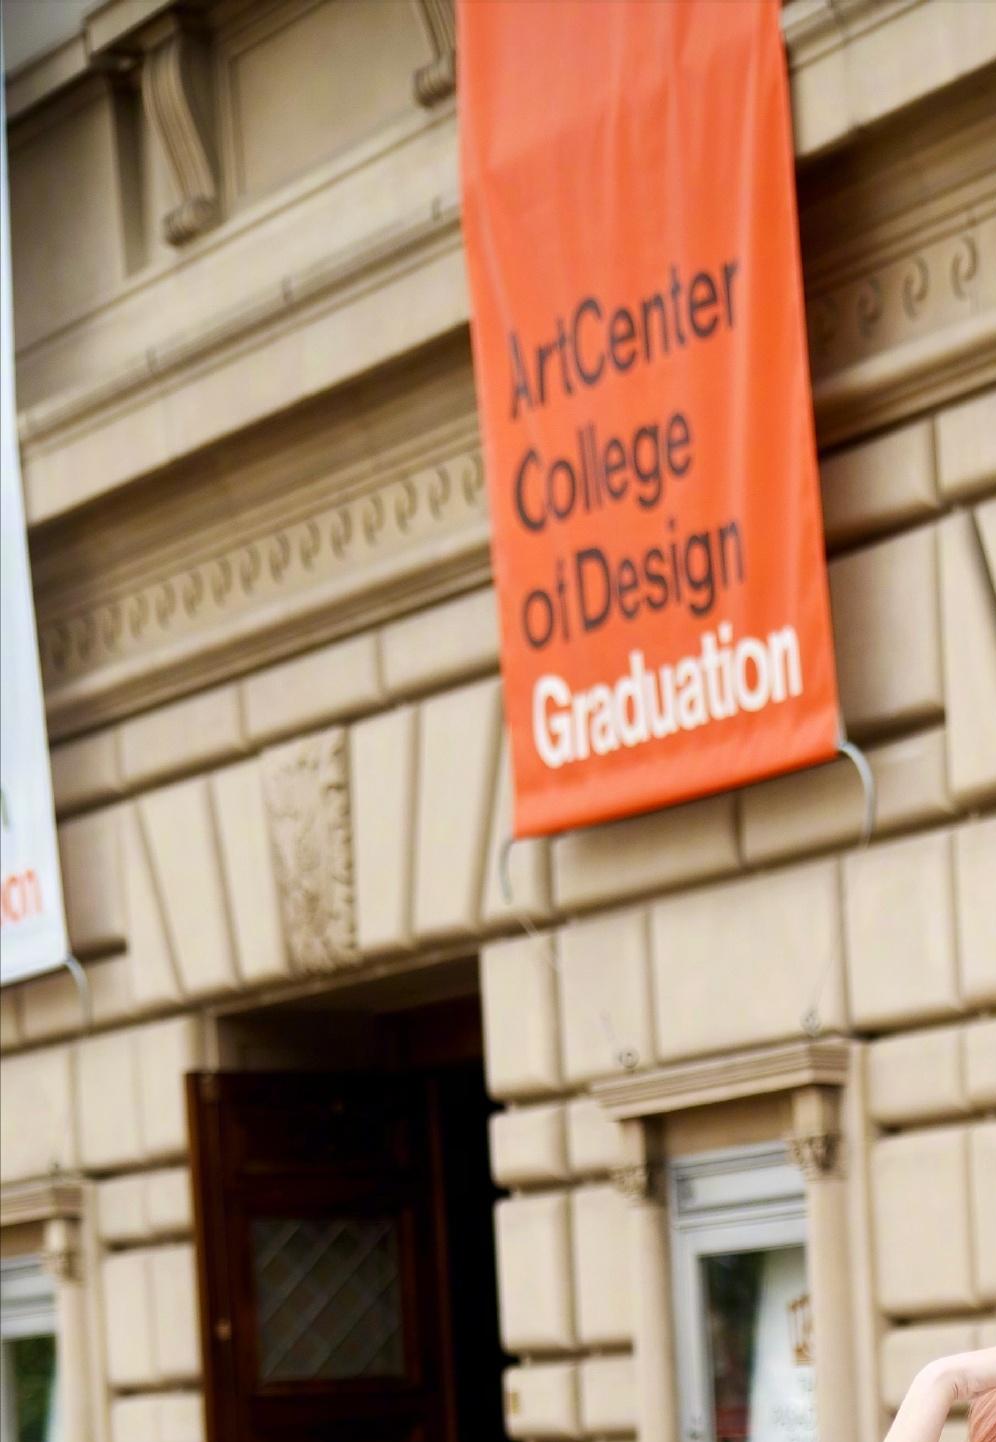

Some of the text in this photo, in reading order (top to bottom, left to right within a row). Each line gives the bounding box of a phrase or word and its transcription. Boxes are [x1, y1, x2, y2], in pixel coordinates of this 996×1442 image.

[510, 256, 739, 419] ArtCenter
[514, 411, 693, 532] College
[573, 517, 746, 634] Design
[532, 620, 803, 768] Graduation
